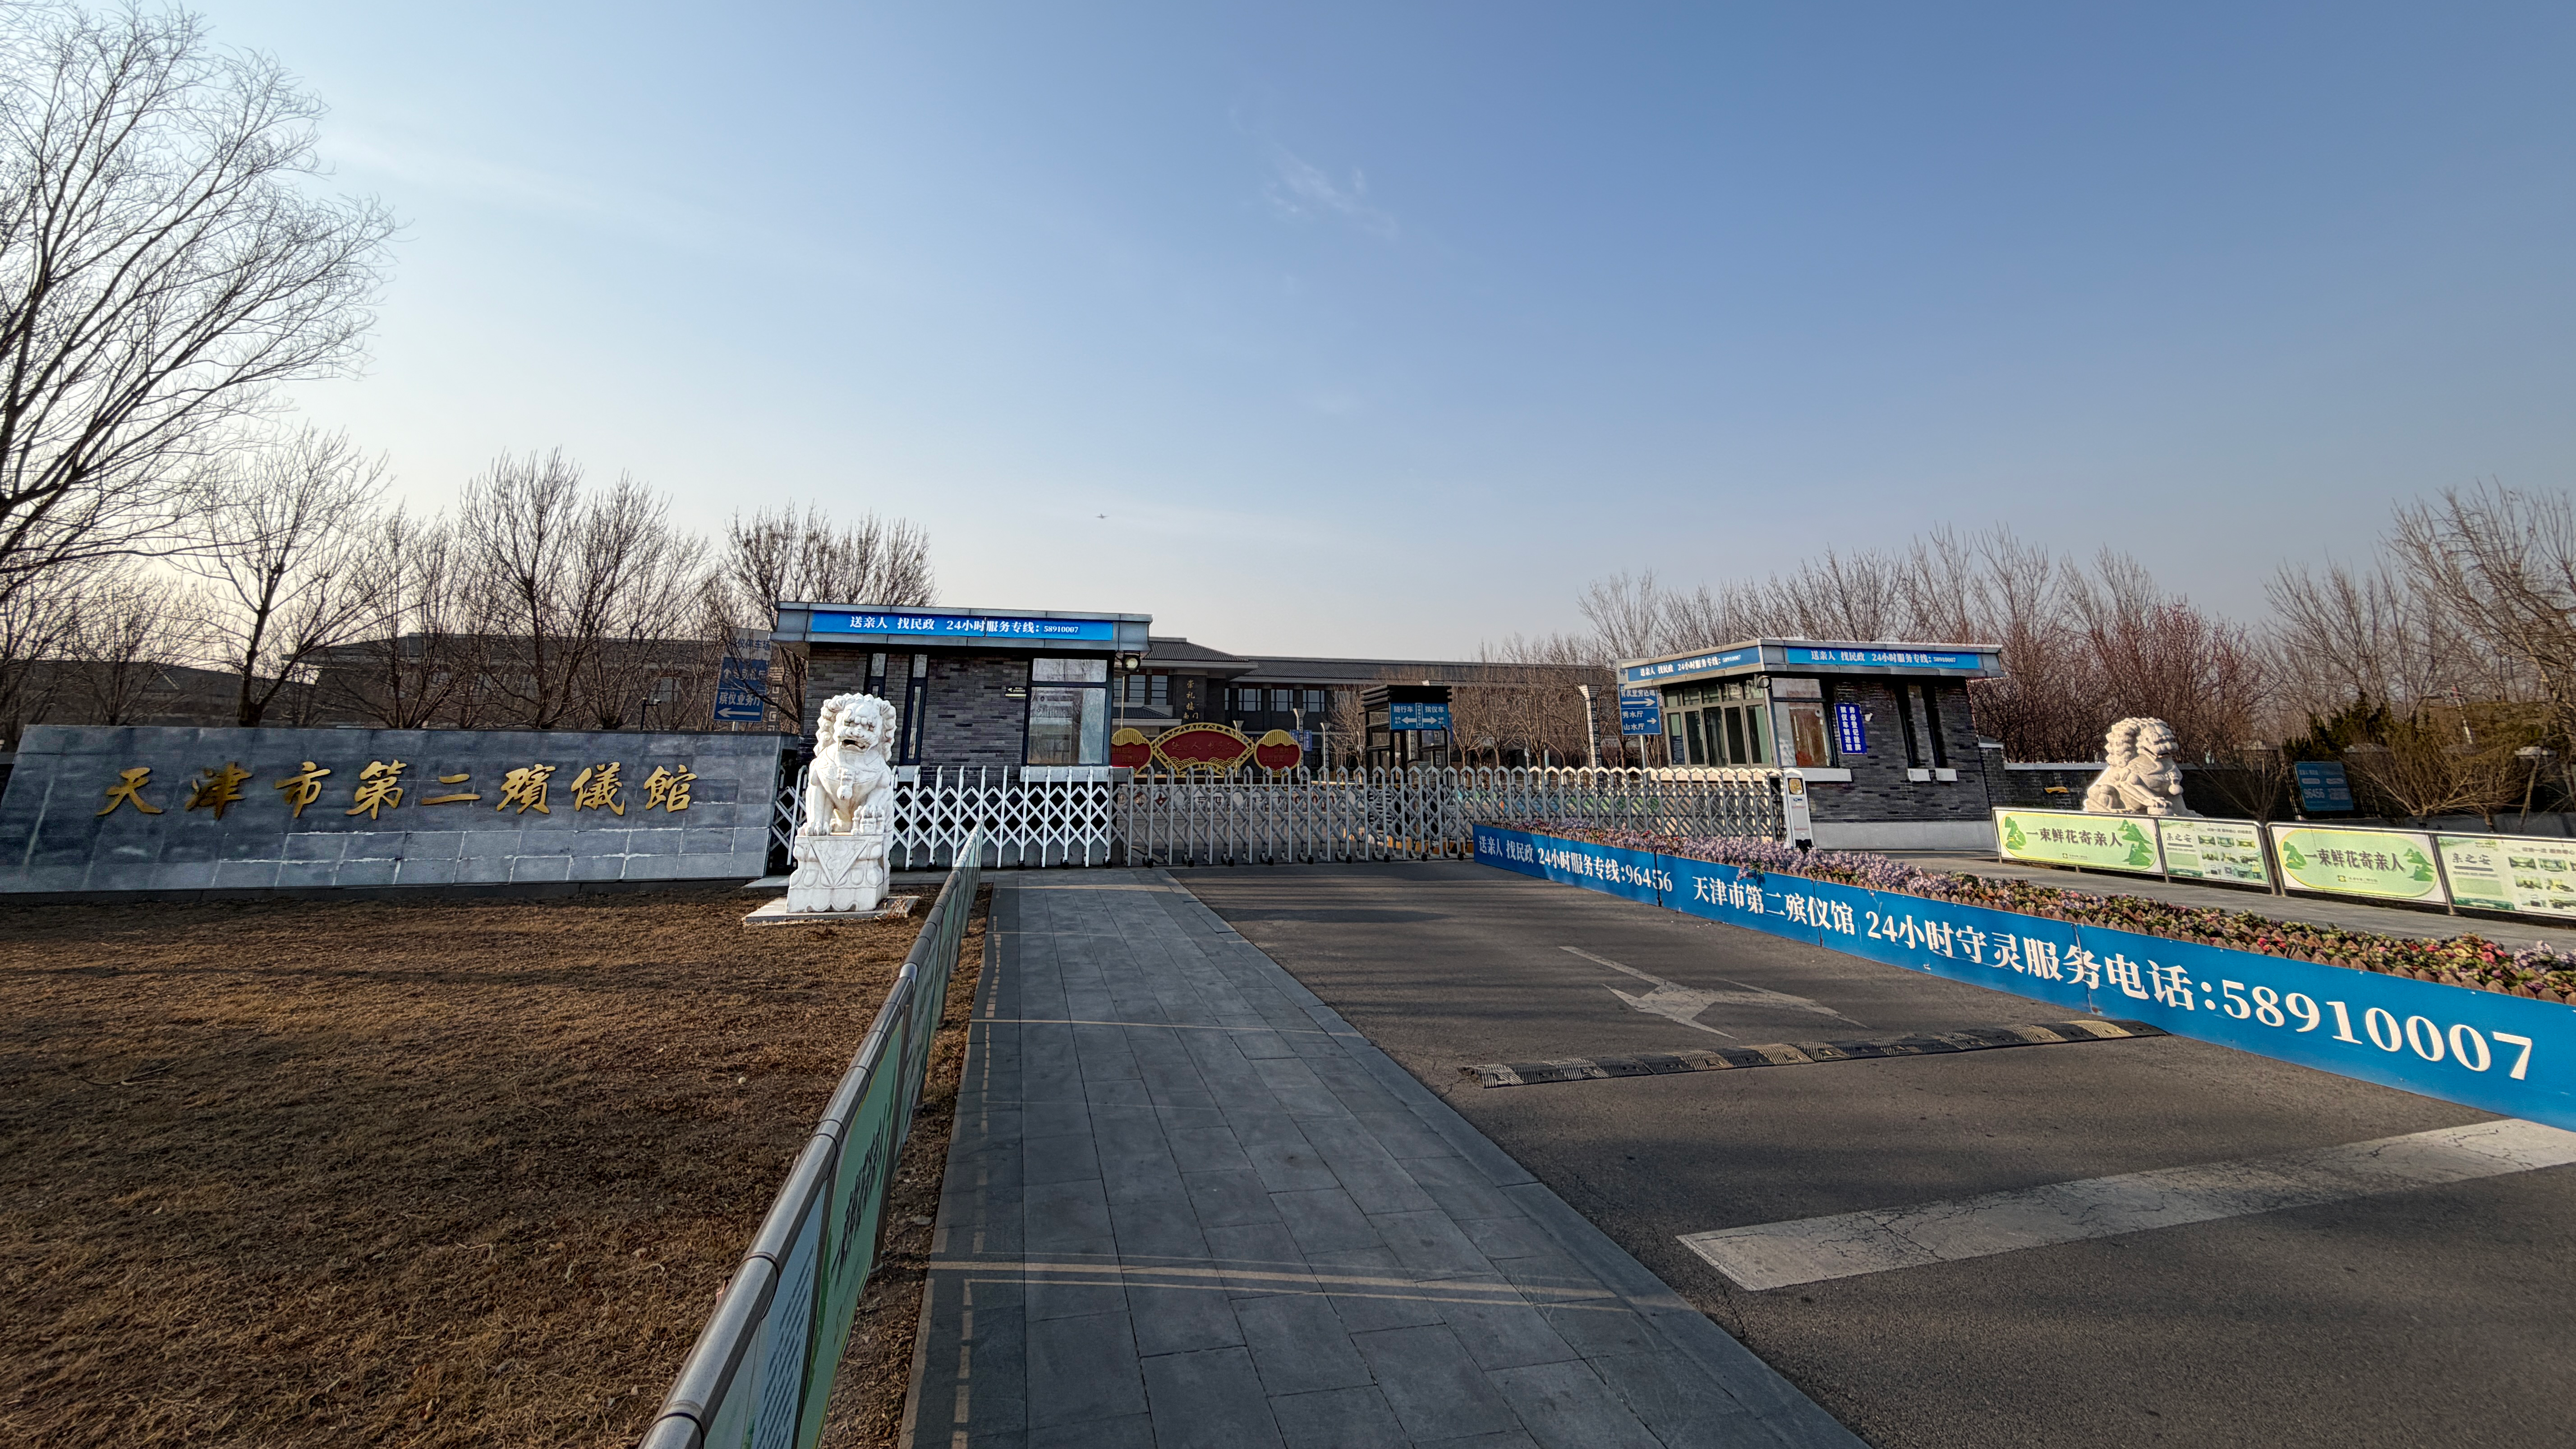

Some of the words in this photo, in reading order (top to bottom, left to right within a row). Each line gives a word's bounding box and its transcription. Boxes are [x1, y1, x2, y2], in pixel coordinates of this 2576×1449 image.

[849, 615, 888, 630] 送亲人
[897, 617, 935, 631] 找民政
[1811, 650, 1836, 661] 送亲人
[1840, 651, 1865, 662] 找民政
[1640, 667, 1656, 676] 送亲人
[1658, 663, 1674, 675] 找民政
[718, 691, 761, 706] 殡仪业务厅
[1622, 711, 1643, 719] 秀水厅
[1624, 723, 1645, 731] 山水厅
[97, 760, 697, 819] 天津市第二殯儀館
[2026, 827, 2123, 848] 一束鲜花寄亲人
[2304, 848, 2406, 873] 一束鲜花寄亲人
[1479, 834, 1503, 858] 送亲人
[1506, 842, 1534, 865] 找民政
[1538, 847, 1673, 892] 24小时服务专线:96456
[1692, 876, 1856, 936] 天津市第二殡仪馆
[1866, 910, 2533, 1080] 24小时守灵服务电话:58910007
